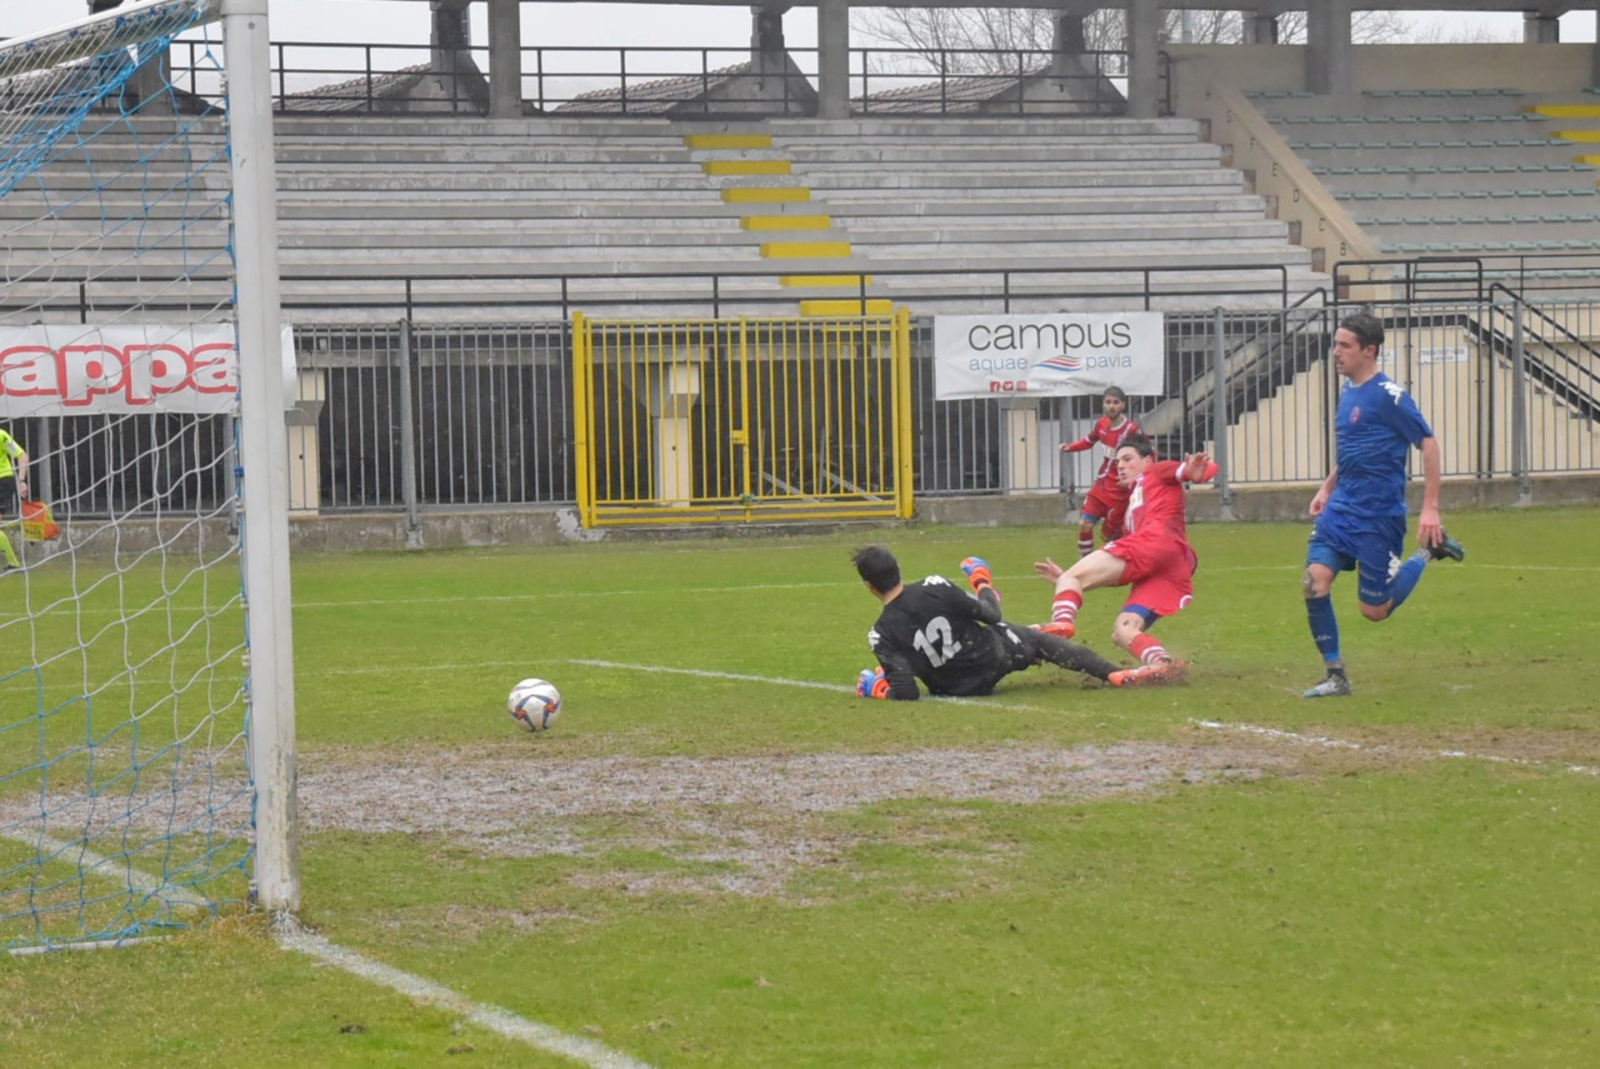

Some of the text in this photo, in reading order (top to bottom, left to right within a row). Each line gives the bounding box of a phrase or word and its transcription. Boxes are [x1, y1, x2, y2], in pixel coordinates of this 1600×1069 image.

[1272, 162, 1278, 177] E
[1293, 189, 1299, 203] D
[1319, 217, 1325, 231] C
[1340, 242, 1346, 256] B
[968, 320, 1132, 355] campus
[969, 353, 1133, 374] aquae pavia
[0, 343, 238, 406] appa
[913, 615, 963, 669] 12
